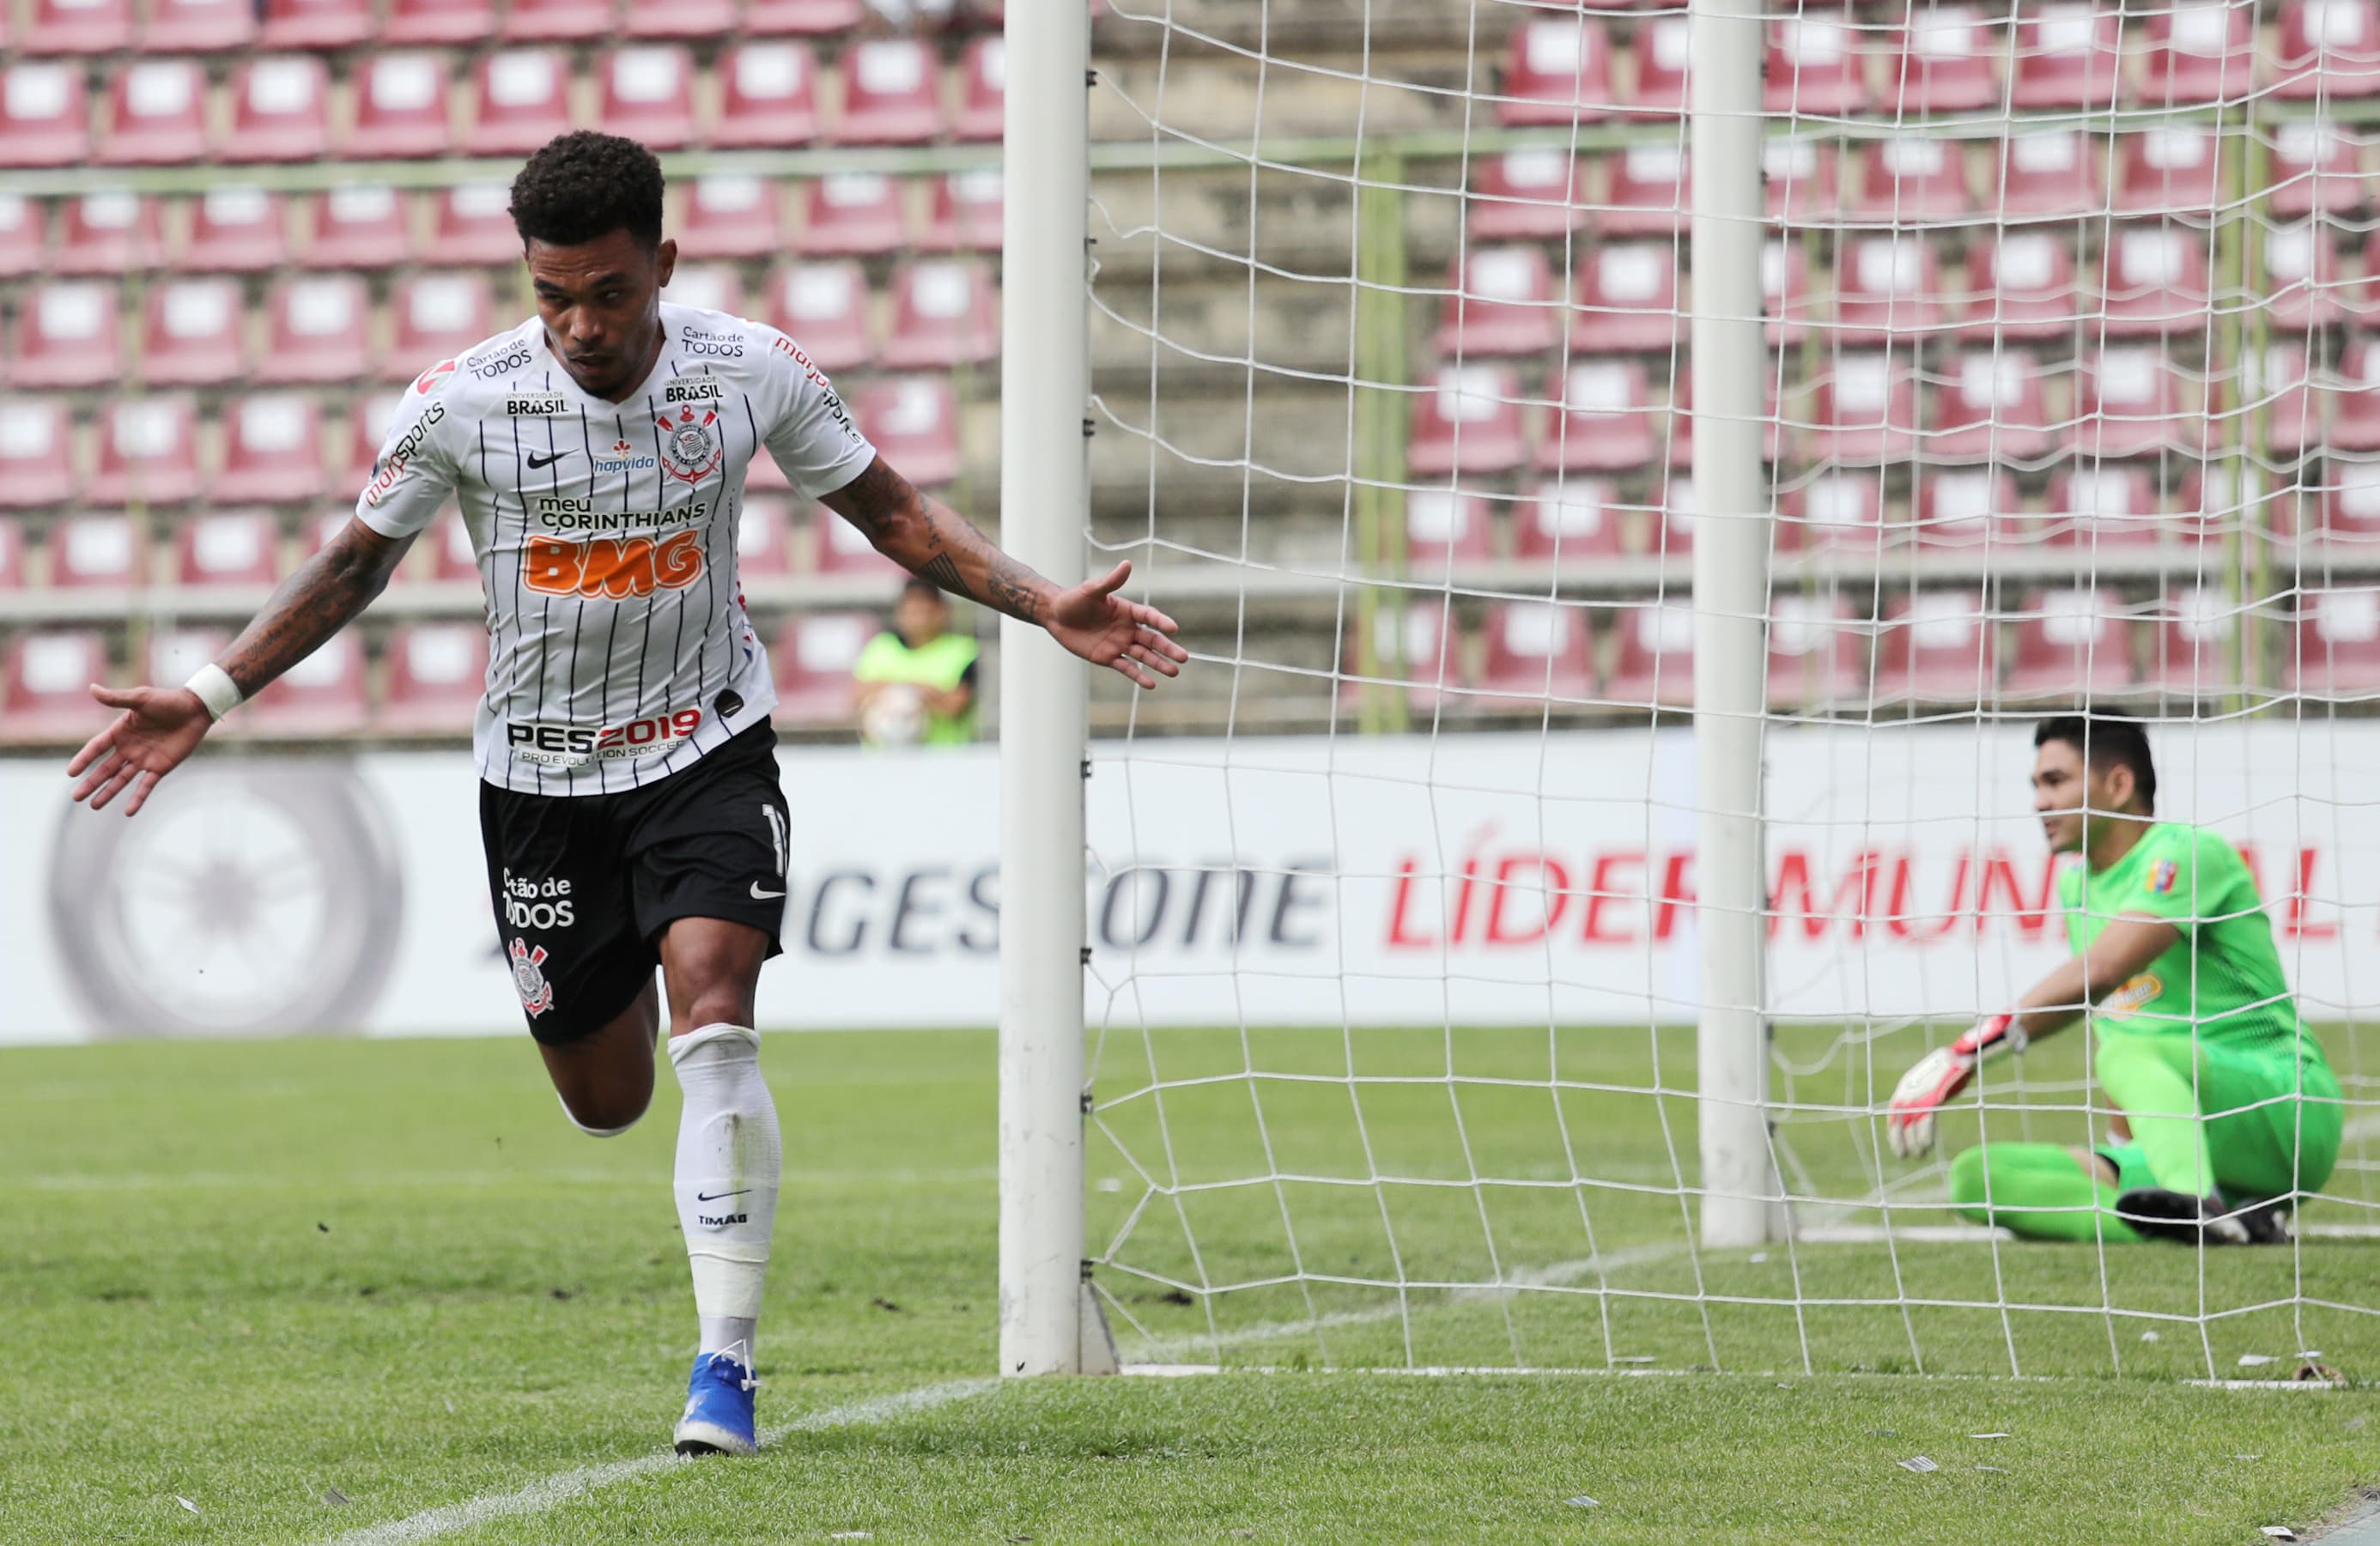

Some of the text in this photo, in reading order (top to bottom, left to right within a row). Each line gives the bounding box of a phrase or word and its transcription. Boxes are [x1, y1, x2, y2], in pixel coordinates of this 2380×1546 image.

[509, 339, 525, 351] de
[727, 330, 744, 343] de
[682, 338, 744, 358] TODOS
[470, 349, 532, 381] TODOS
[664, 376, 717, 386] UNIVERSIDADE
[666, 384, 724, 403] BRASIL
[507, 399, 569, 415] BRASIL
[594, 455, 655, 474] hapvida
[539, 497, 591, 512] meu
[540, 502, 707, 530] CORINTHIANS
[523, 529, 705, 599] BMG
[521, 739, 685, 767] PRO EVOLUTION SOCCER
[541, 876, 572, 898] de
